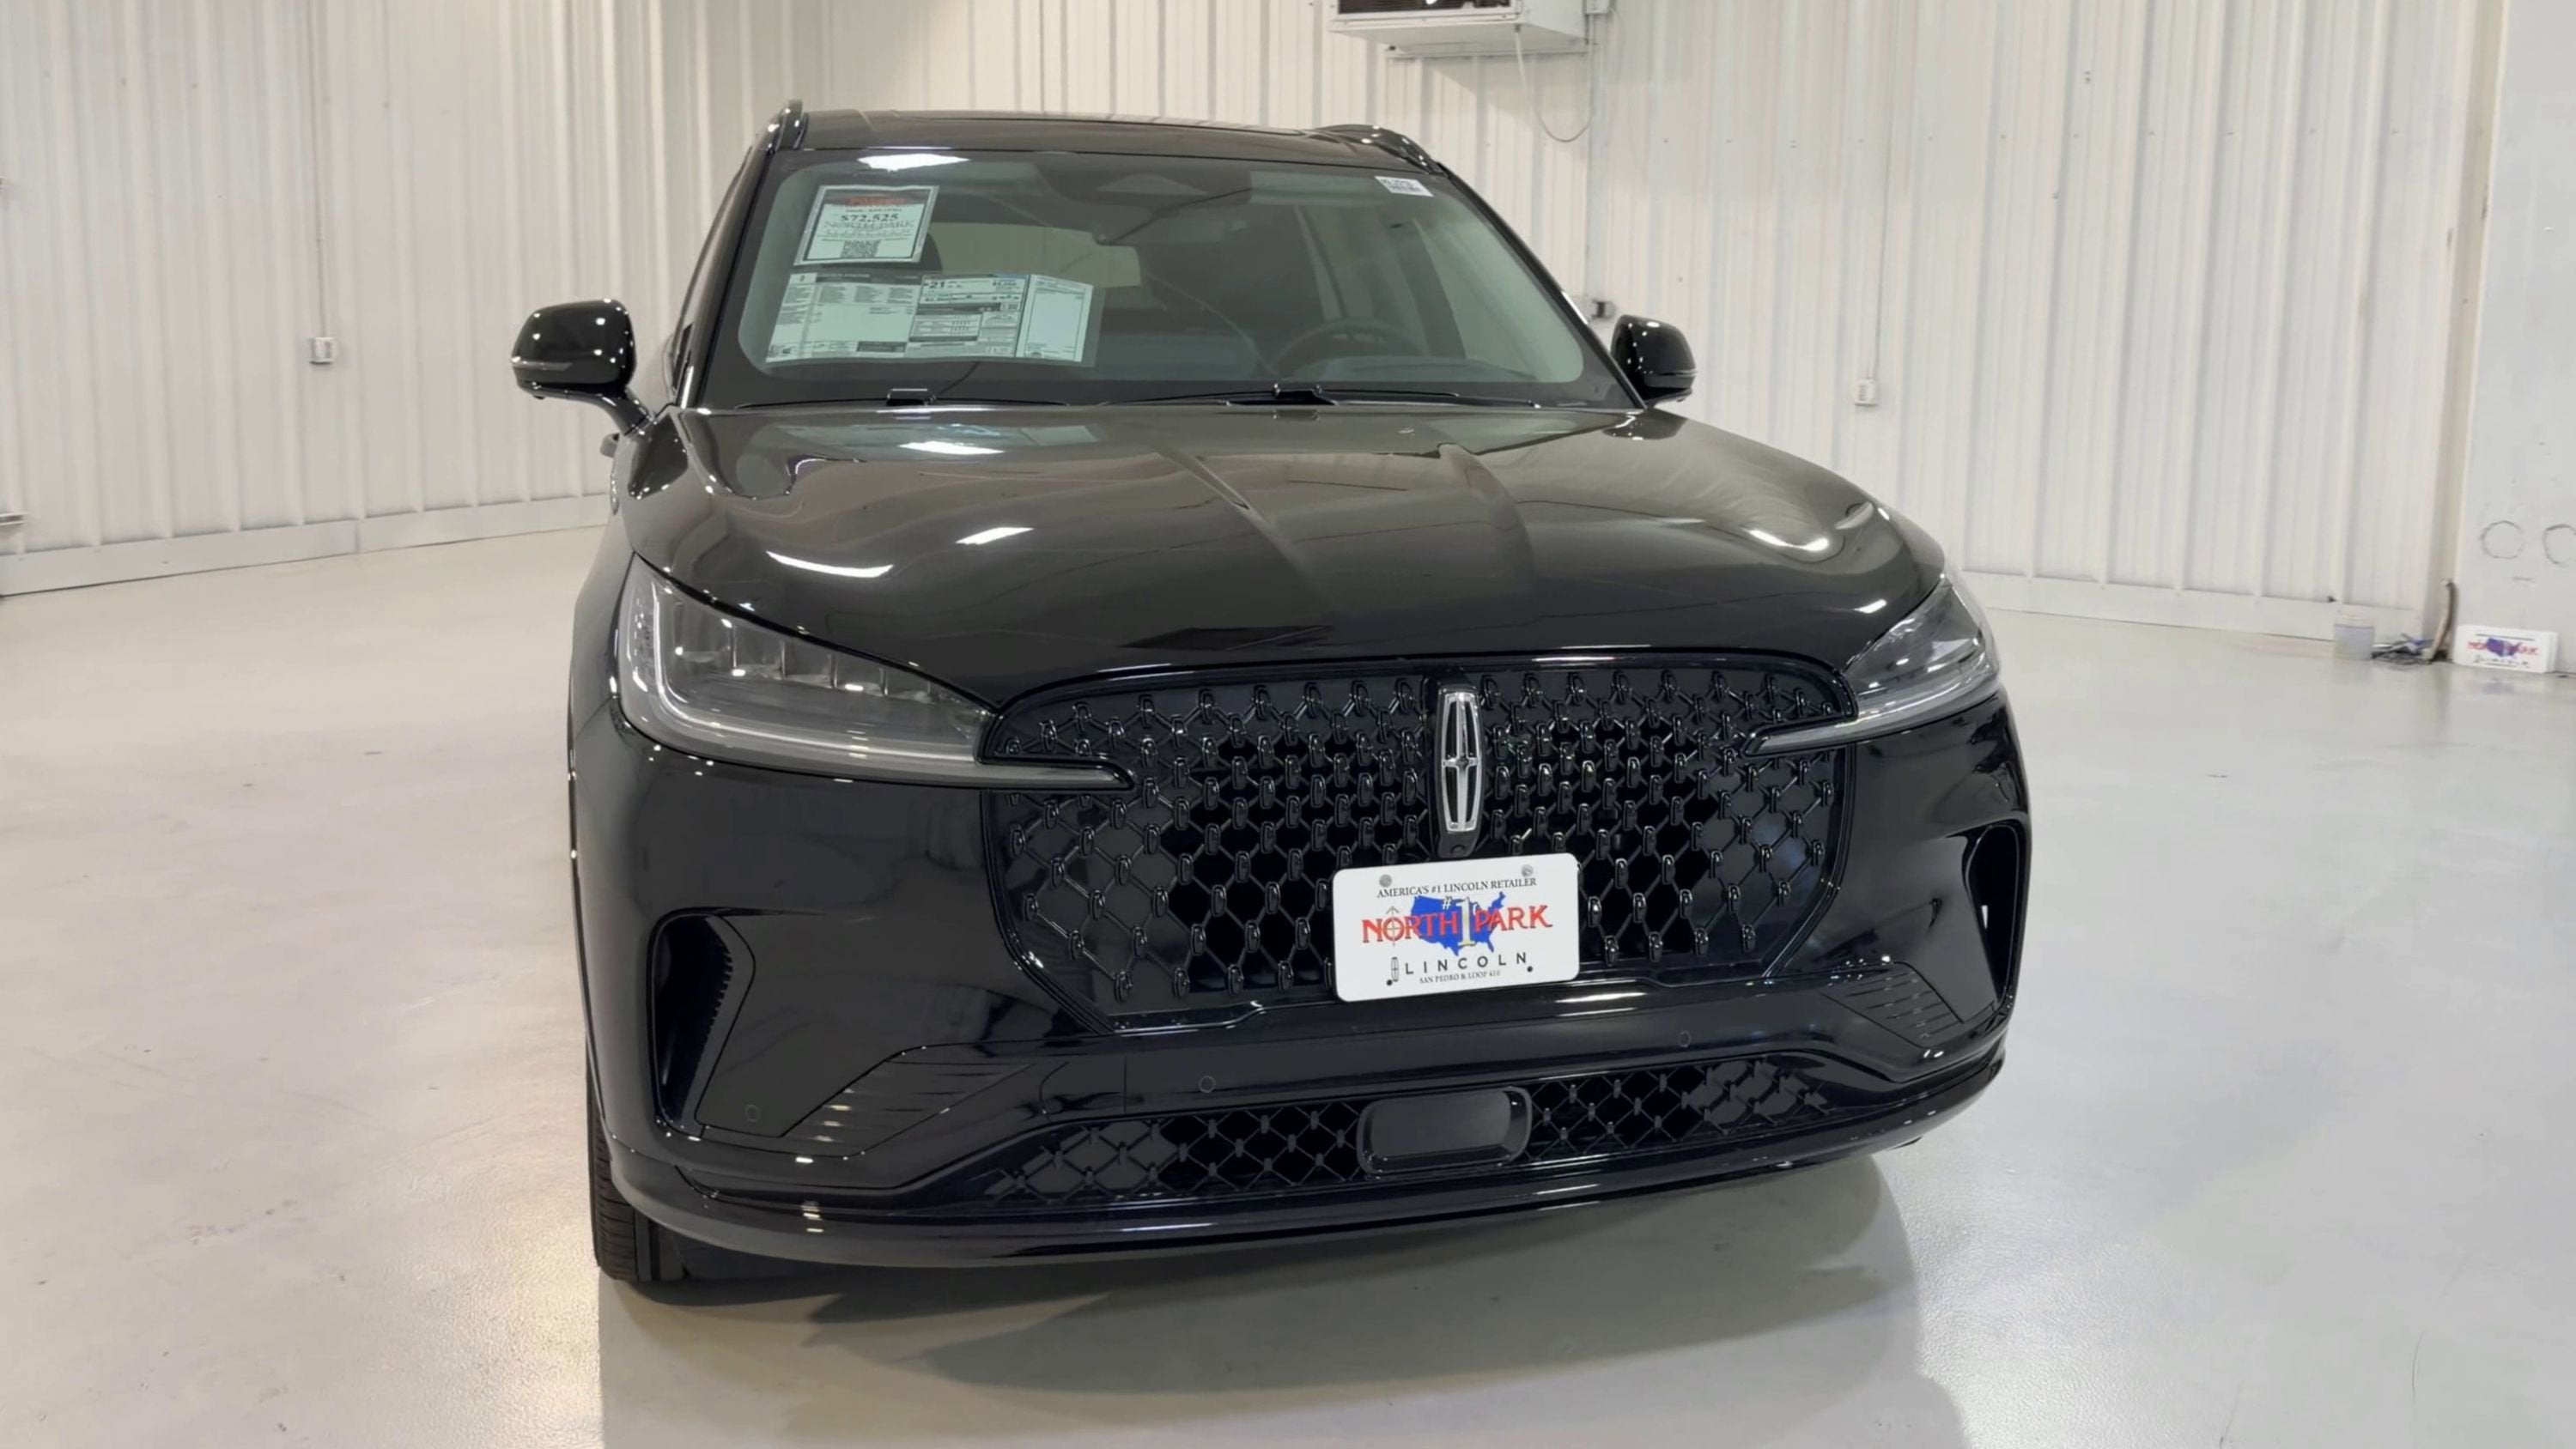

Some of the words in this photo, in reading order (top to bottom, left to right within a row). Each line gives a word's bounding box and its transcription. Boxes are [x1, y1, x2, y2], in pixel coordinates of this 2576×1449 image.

[1377, 885, 1430, 899] AMERICA'S
[1431, 884, 1441, 894] #1
[1443, 880, 1489, 893] LINCOLN
[1491, 877, 1536, 888] RETAILER
[1362, 912, 1458, 943] NORTH
[1474, 905, 1553, 933] PARK
[1405, 952, 1527, 975] LINCOLN
[1435, 973, 1460, 983] PEDRO
